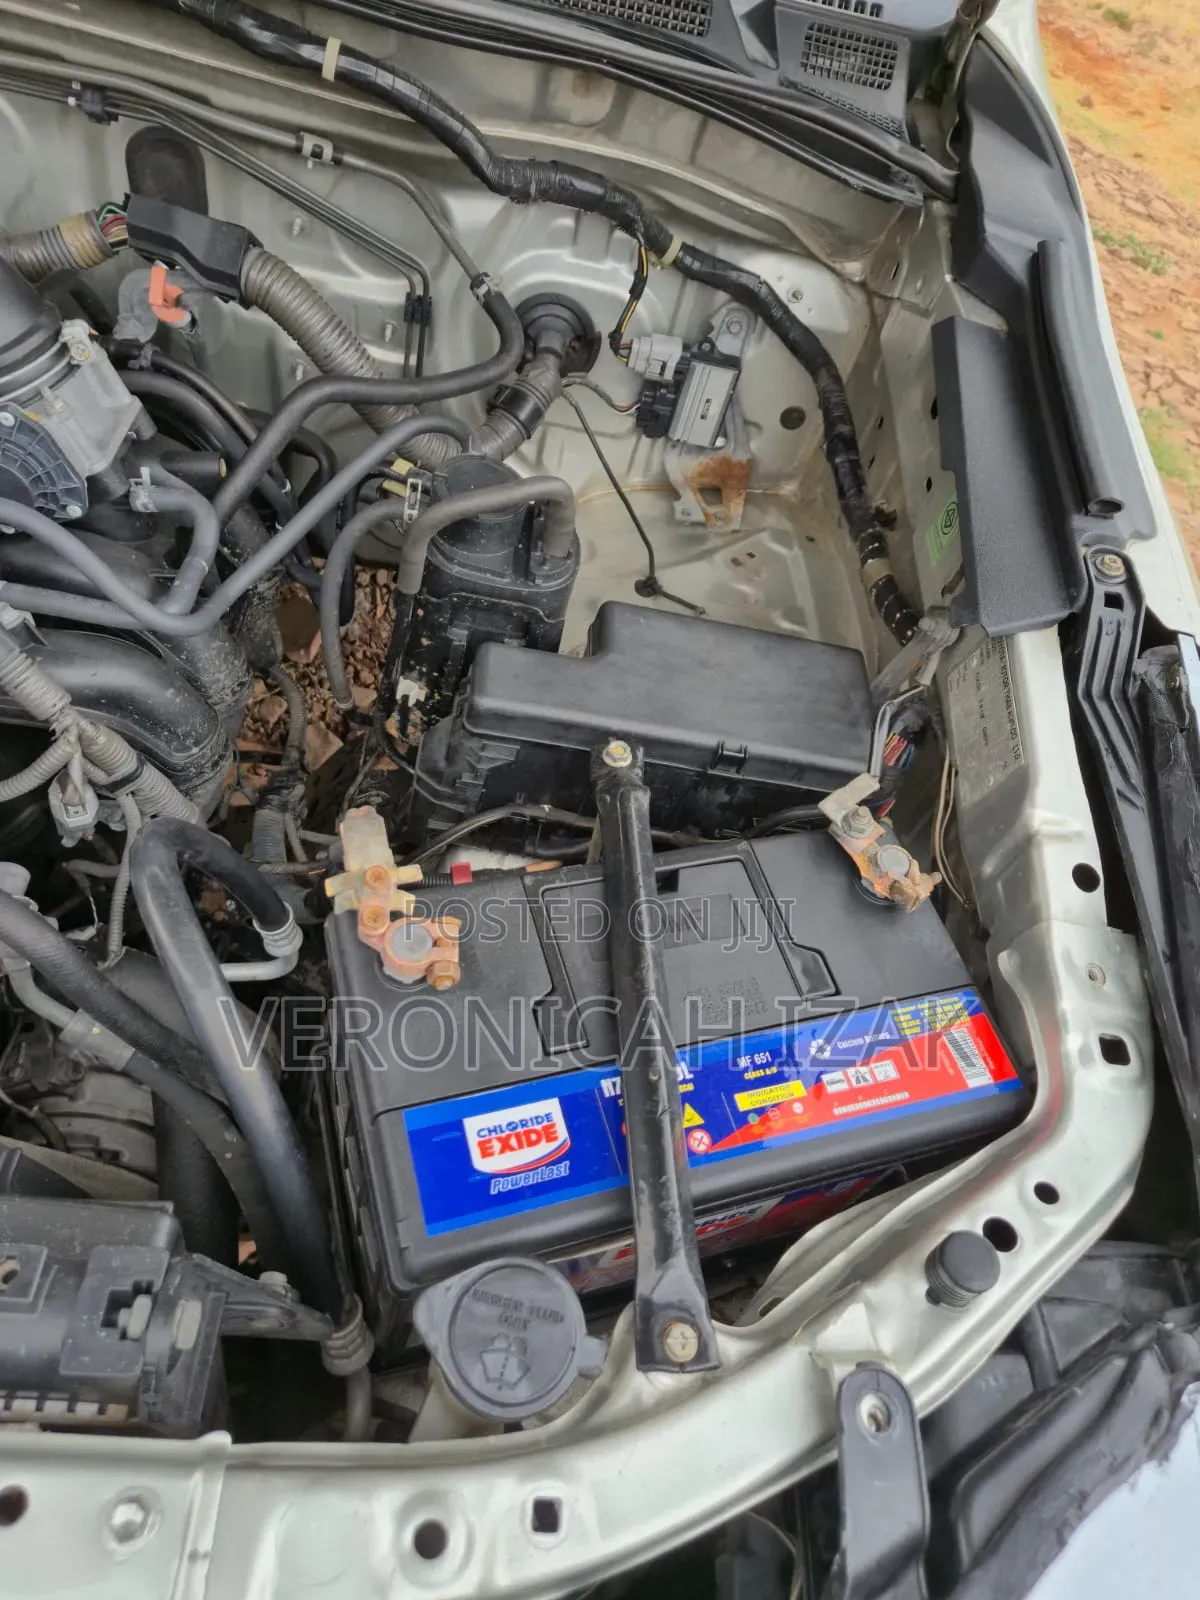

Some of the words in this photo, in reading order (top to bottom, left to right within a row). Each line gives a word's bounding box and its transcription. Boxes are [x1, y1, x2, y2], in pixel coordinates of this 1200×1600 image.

[753, 1051, 772, 1065] 651
[746, 1083, 791, 1099] INDICATOR
[750, 1091, 795, 1107] CONDITION
[476, 1112, 554, 1139] CHLORIDE
[477, 1122, 560, 1160] EXIDE
[489, 1160, 570, 1195] PowerLast
